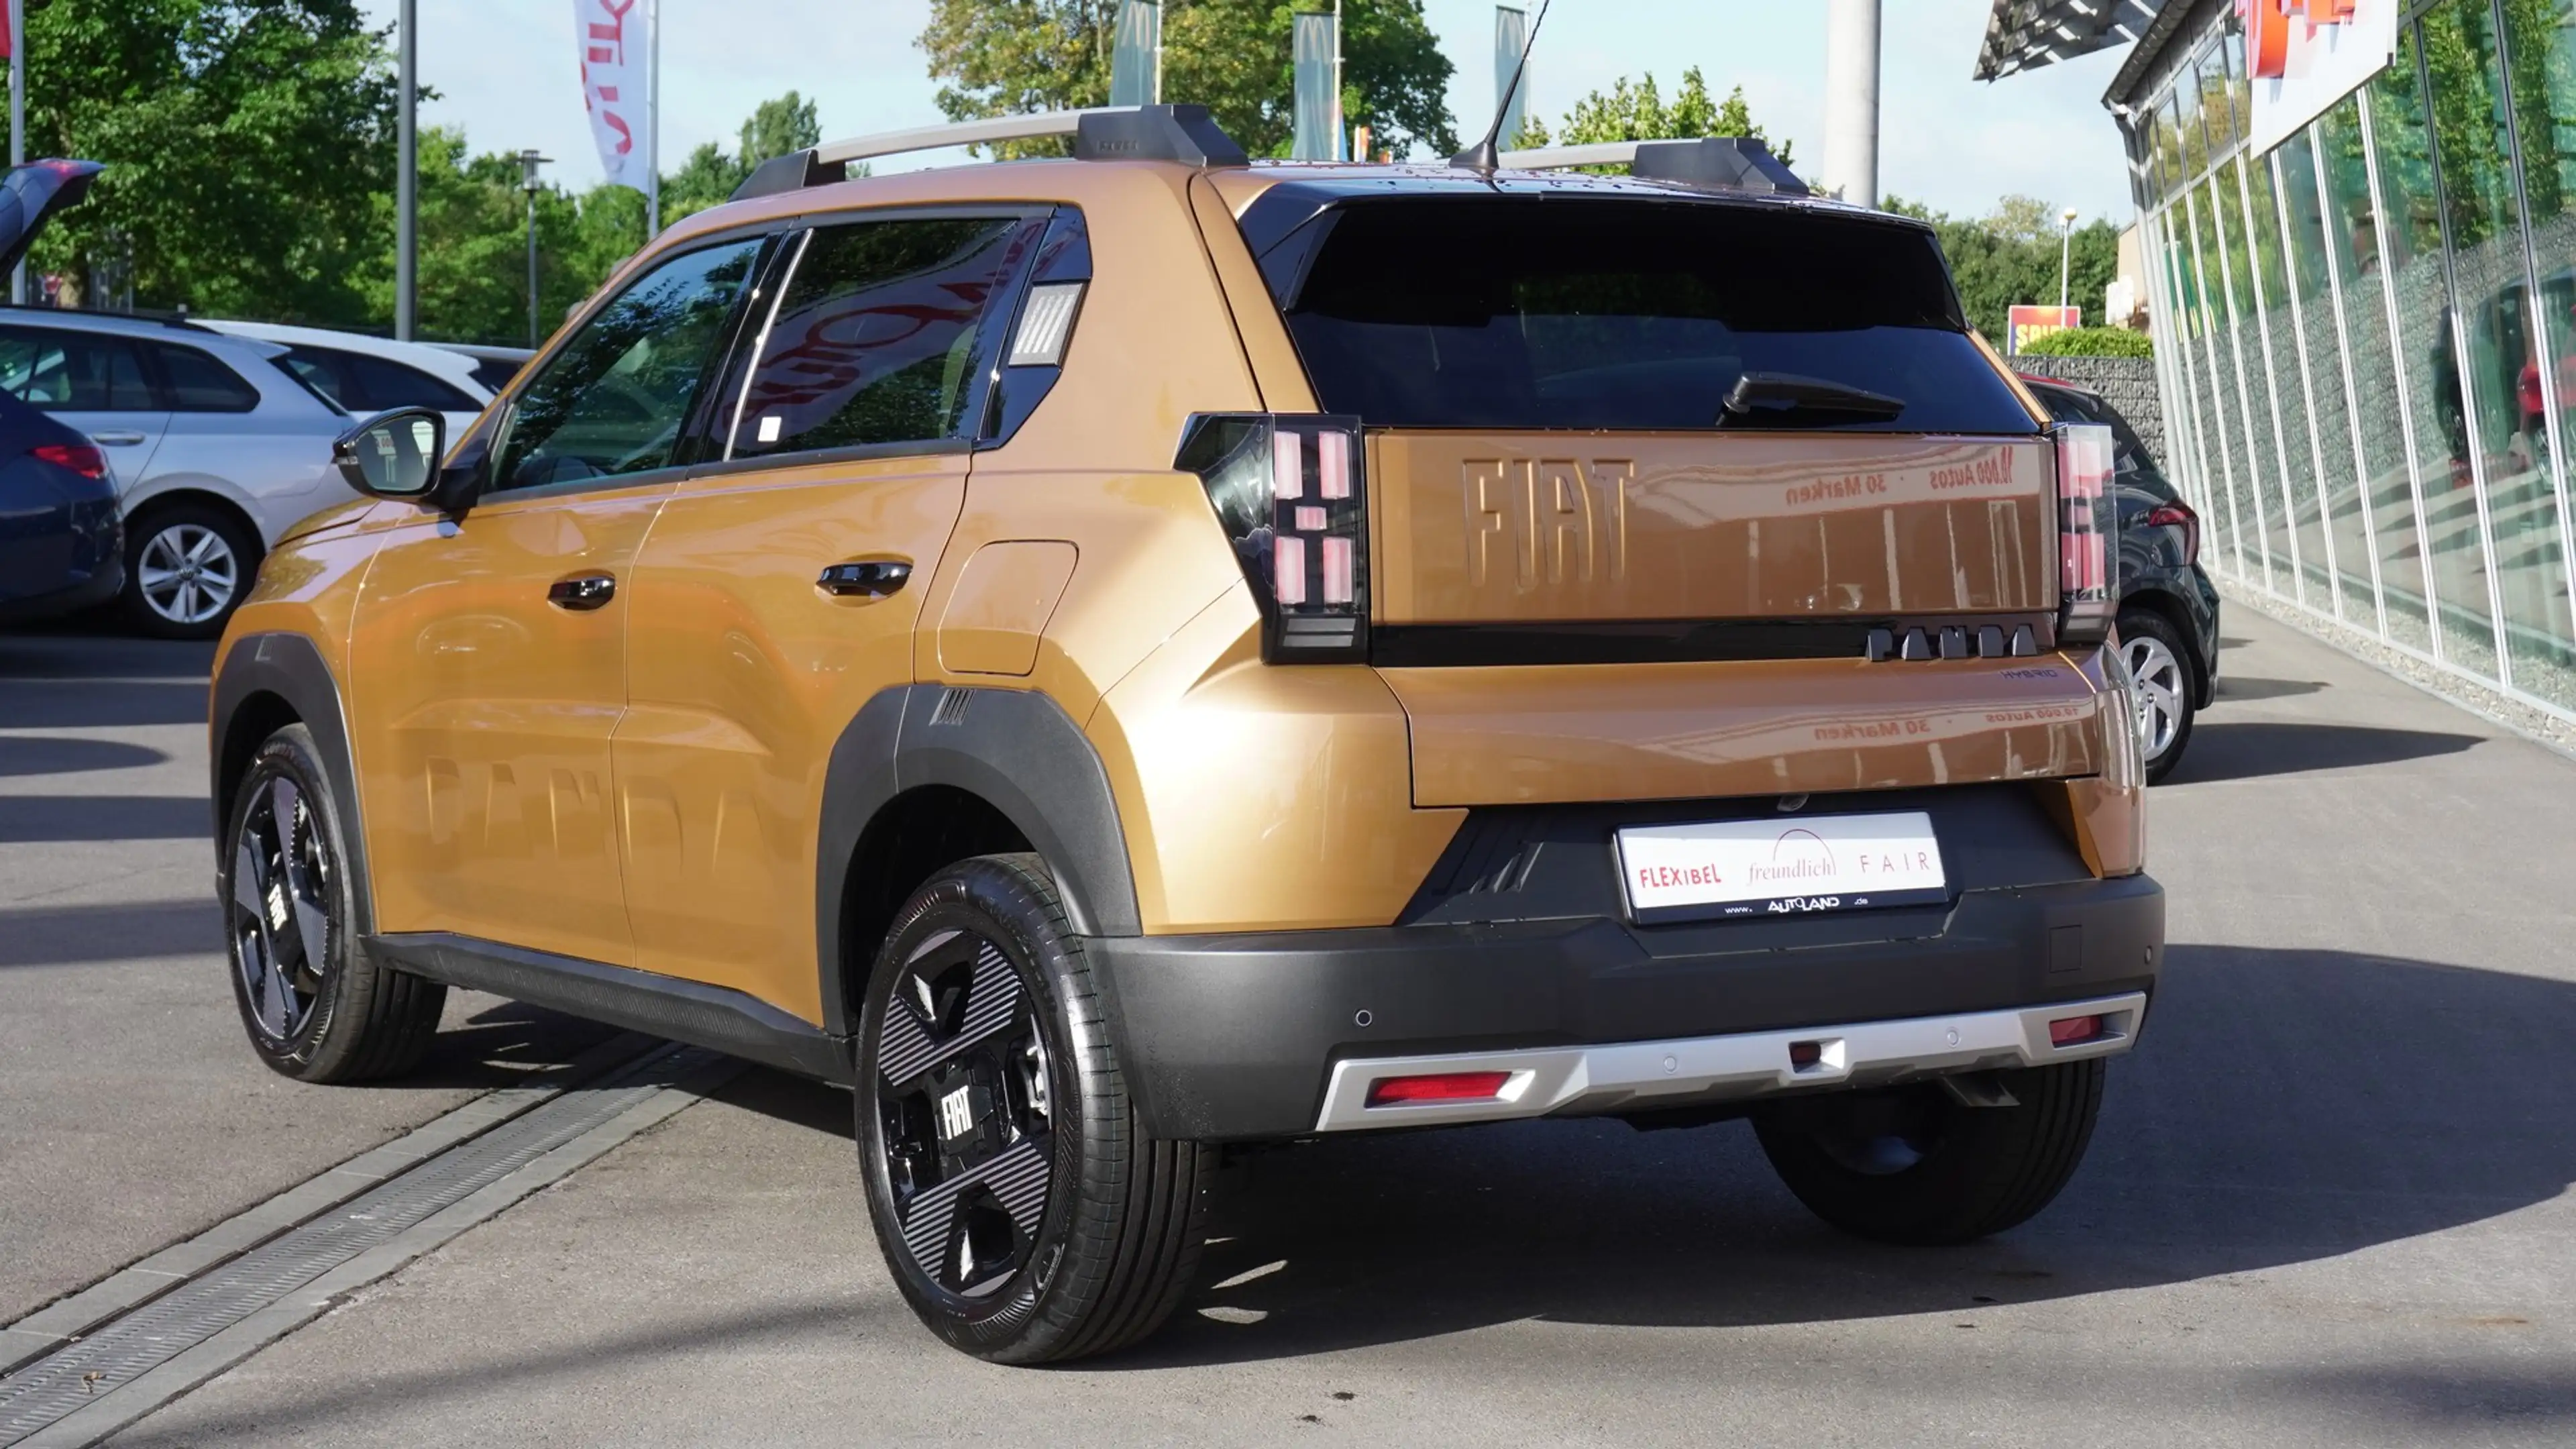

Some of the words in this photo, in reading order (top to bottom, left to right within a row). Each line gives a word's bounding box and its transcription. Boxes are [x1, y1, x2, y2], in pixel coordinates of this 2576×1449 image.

[1462, 458, 1635, 586] FIAT
[1866, 623, 2039, 663] PANDA
[1746, 857, 1833, 886] freundlich
[1767, 896, 1840, 913] AUTOLAND
[941, 1085, 973, 1140] FIAT
